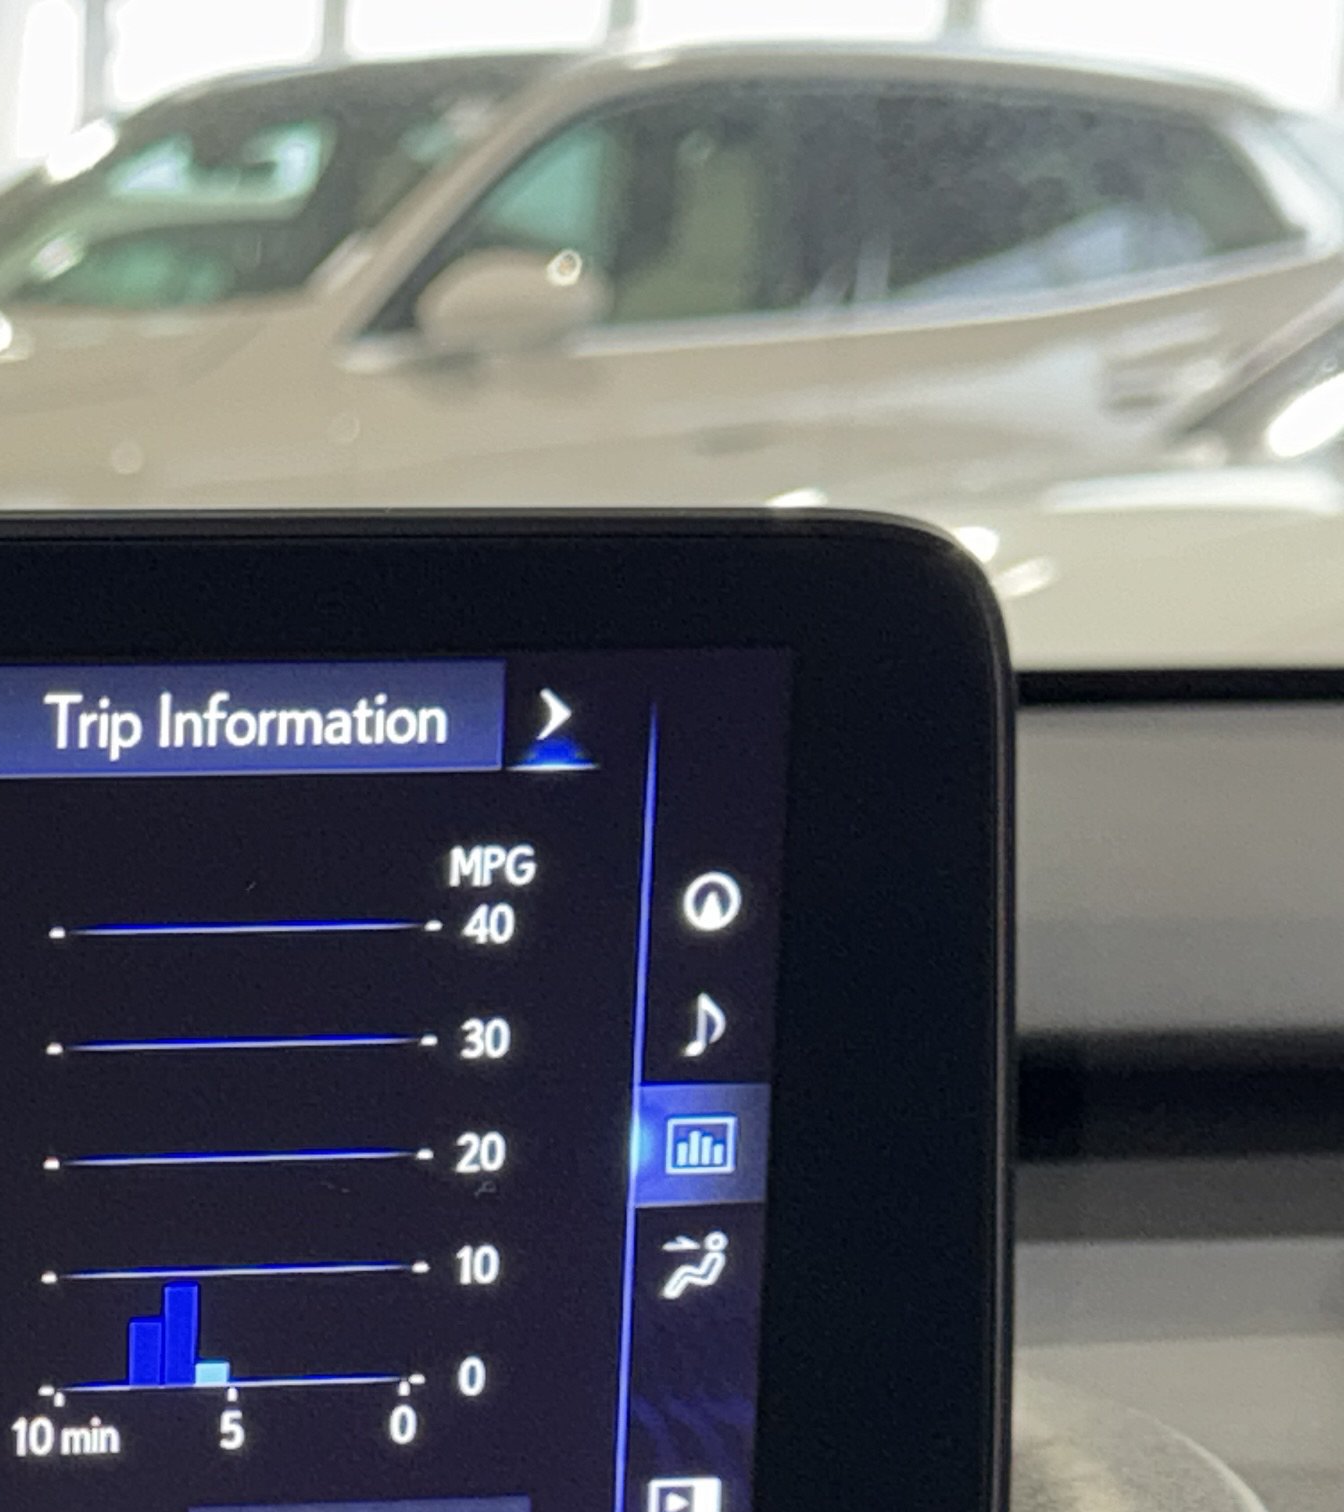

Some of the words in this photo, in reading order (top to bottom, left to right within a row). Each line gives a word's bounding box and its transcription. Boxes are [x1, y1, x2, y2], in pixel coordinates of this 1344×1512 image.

[43, 692, 143, 761] Trip
[159, 691, 448, 748] Information
[449, 845, 537, 887] MPG
[462, 903, 516, 945] 40
[460, 1017, 511, 1060] 30
[455, 1131, 506, 1174] 20
[455, 1244, 500, 1286] 10
[457, 1356, 486, 1397] 0
[11, 1416, 55, 1457] 10
[60, 1416, 121, 1456] min
[219, 1409, 245, 1451] 5
[389, 1404, 417, 1445] 0
